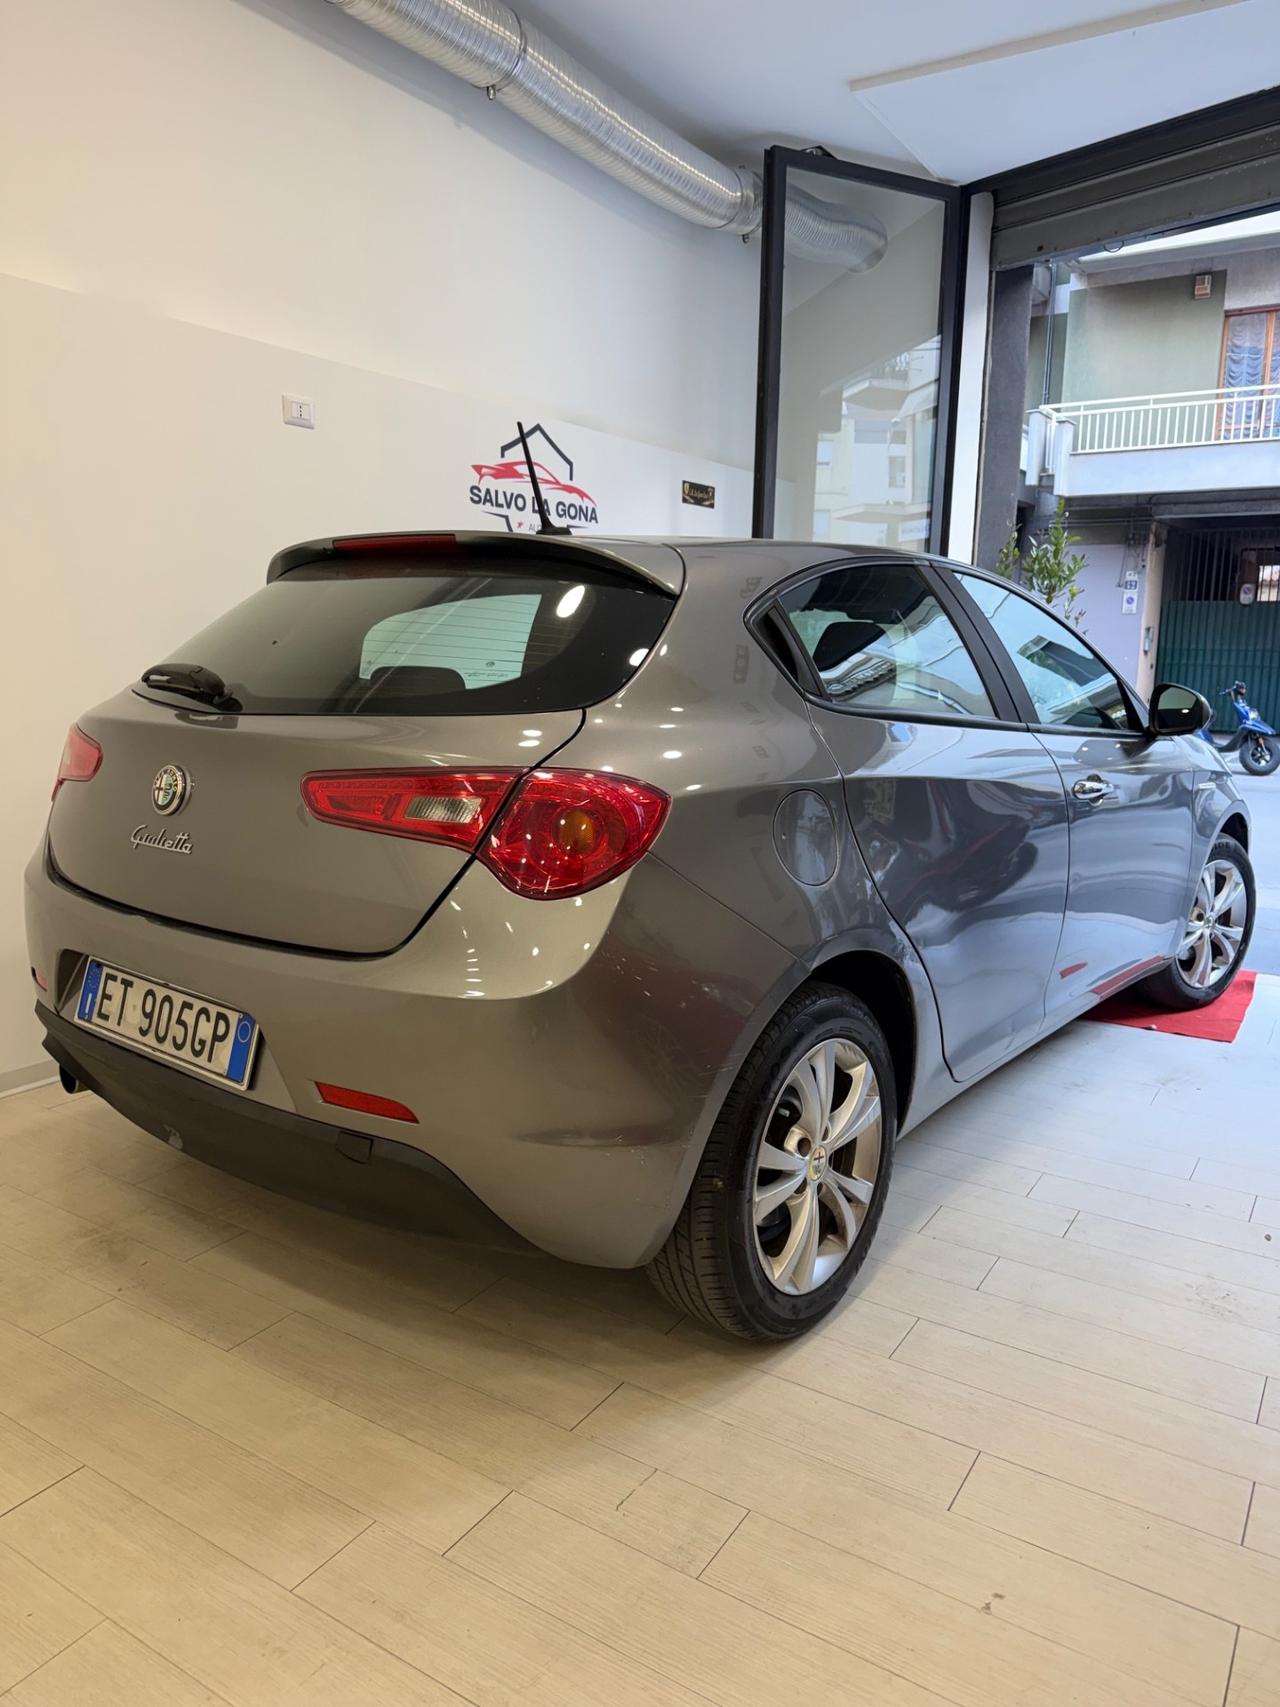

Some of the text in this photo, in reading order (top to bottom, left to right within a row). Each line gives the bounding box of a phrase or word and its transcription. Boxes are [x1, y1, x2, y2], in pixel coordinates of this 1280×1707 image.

[469, 485, 527, 512] SALVO
[555, 501, 599, 524] GONA
[130, 825, 193, 854] Giulietta
[96, 972, 231, 1064] ET 905GP
